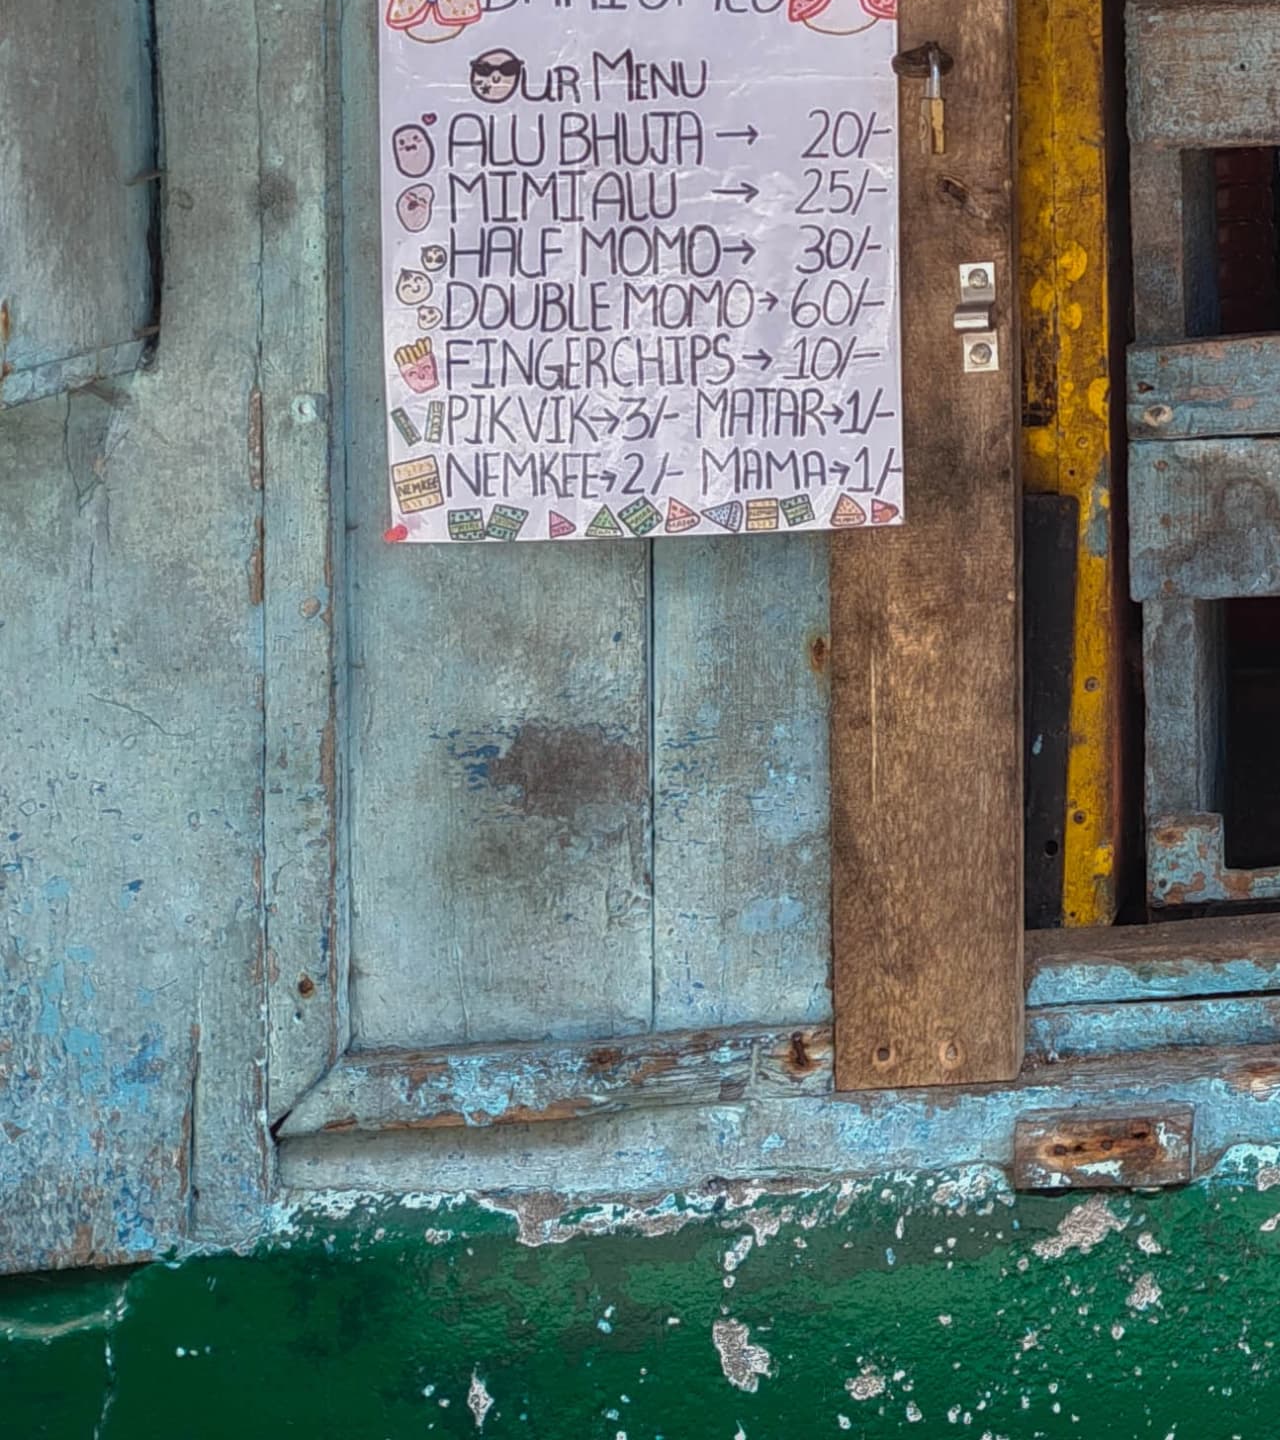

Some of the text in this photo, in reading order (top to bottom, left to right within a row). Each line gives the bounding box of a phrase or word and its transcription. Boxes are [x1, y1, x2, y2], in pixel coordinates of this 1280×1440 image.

[590, 48, 707, 103] MENU
[448, 109, 893, 168] ALU BHUJA 20/-
[450, 167, 888, 224] MIMI ALU 25/-
[448, 222, 883, 279] HALF MOMO 30/-
[441, 277, 885, 333] DOUBLE MOMO 60/-
[783, 334, 881, 382] 10/-
[621, 396, 679, 442] 3/-
[696, 389, 828, 440] MATAR
[840, 387, 895, 437] 1/-
[446, 445, 902, 499] NEMKEE 2/- MAMA 1/-
